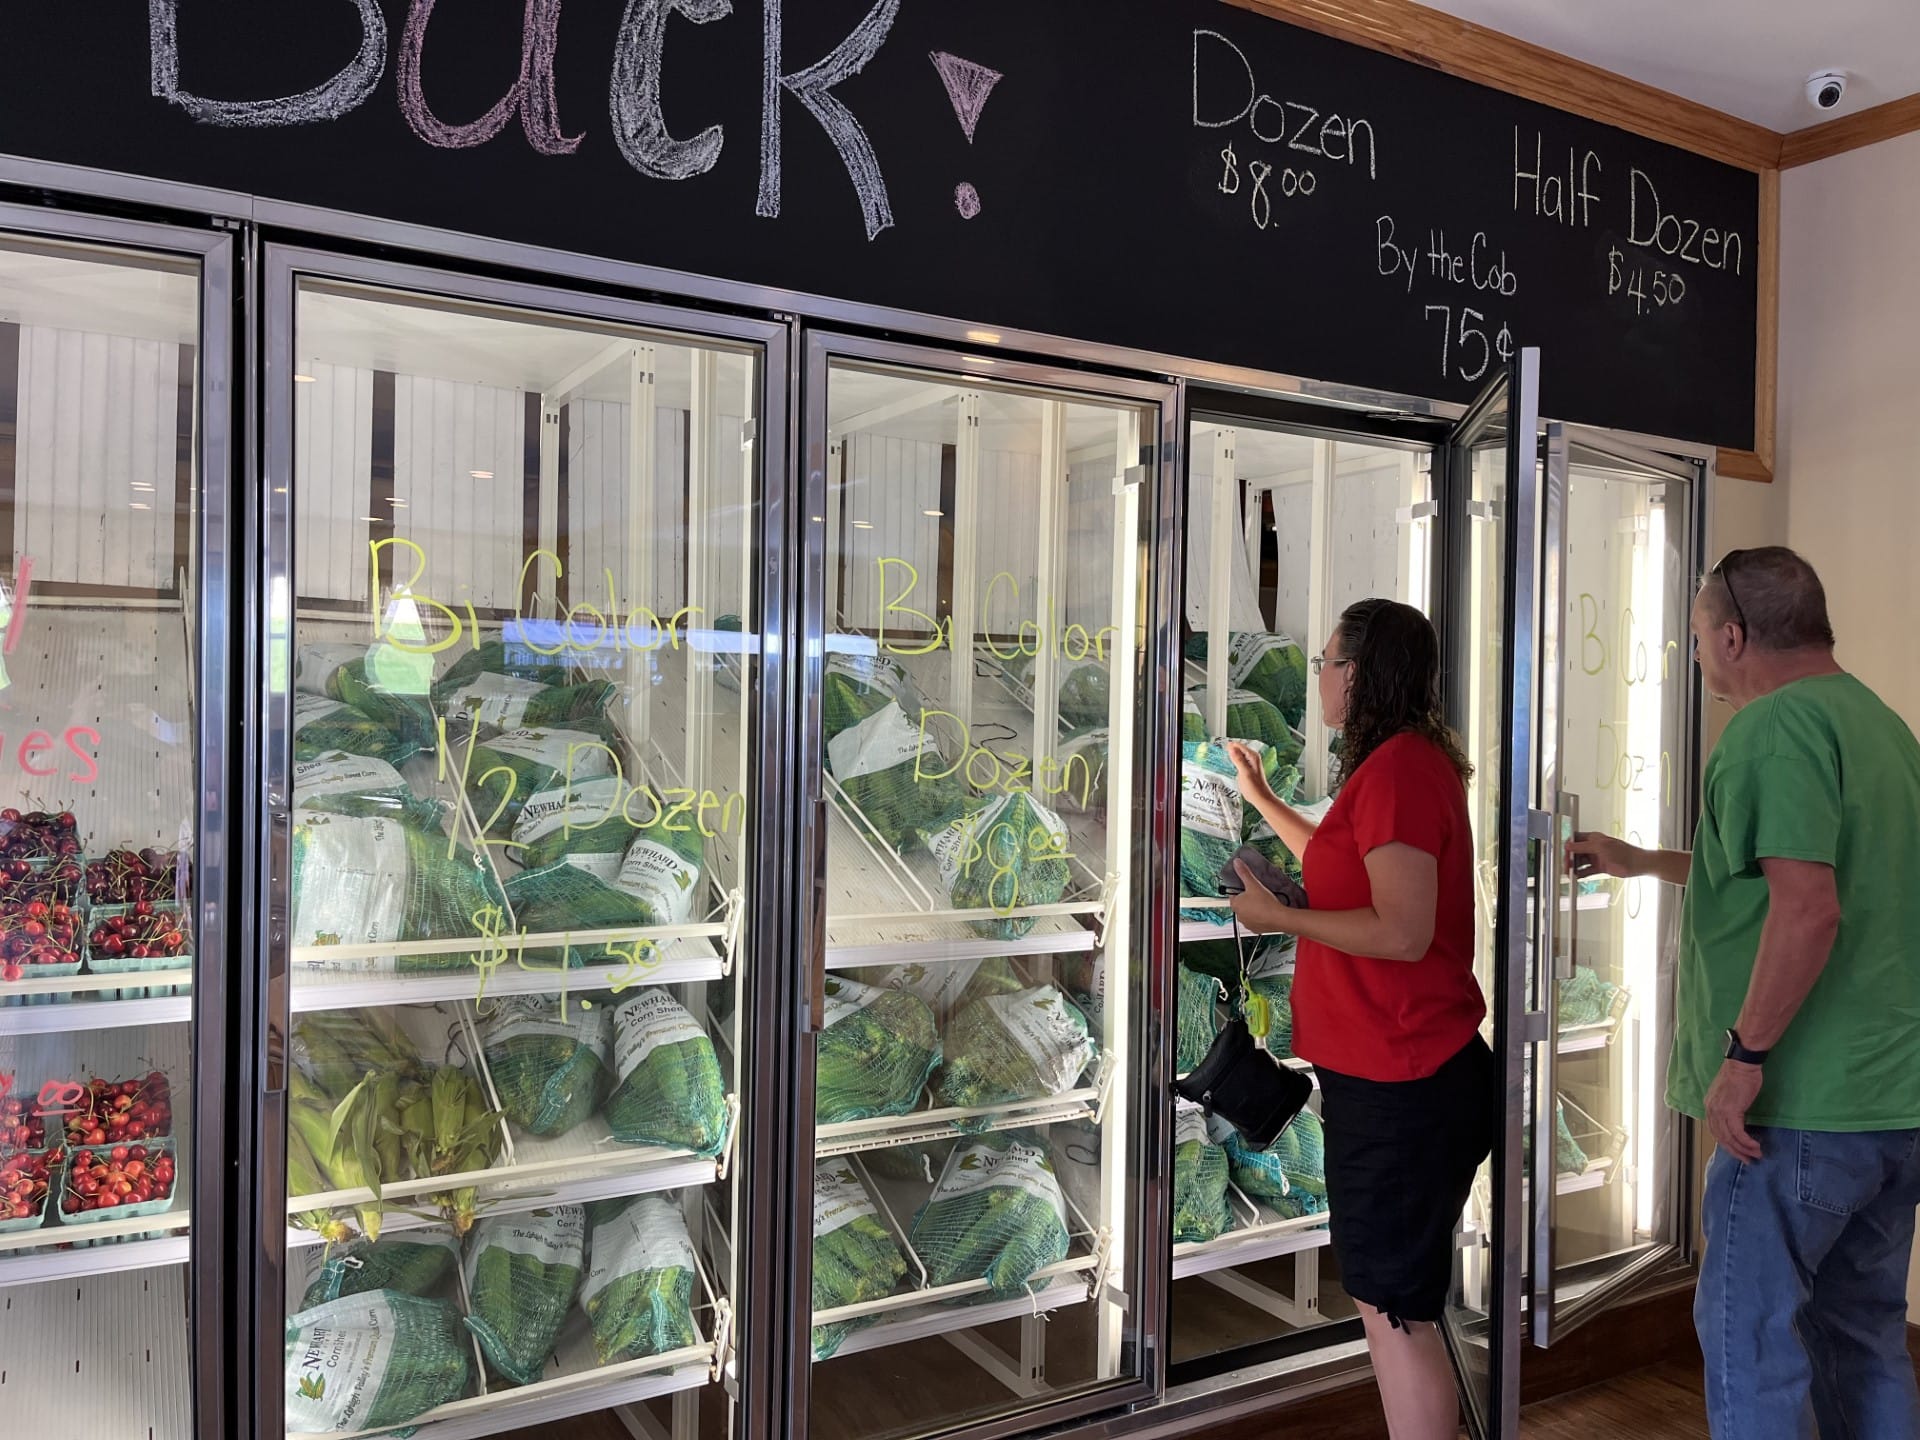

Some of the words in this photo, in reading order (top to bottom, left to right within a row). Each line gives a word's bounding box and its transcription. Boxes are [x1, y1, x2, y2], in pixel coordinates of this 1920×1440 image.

[1192, 28, 1377, 180] Dozen
[1513, 124, 1601, 227] Half
[1626, 167, 1743, 276] Dozen
[1376, 215, 1417, 293] By
[1427, 229, 1465, 283] the
[1470, 231, 1518, 296] Cob
[1607, 245, 1687, 315] $4.50
[369, 537, 481, 655] Bi
[515, 548, 705, 656] Color
[877, 556, 955, 656] Bi
[983, 571, 1121, 662] Color
[1619, 607, 1678, 687] Cor
[0, 725, 101, 784] es
[562, 741, 748, 842] Dozen
[913, 707, 1090, 812] Dozen
[1596, 720, 1672, 808] Dozn
[523, 799, 565, 820] NEWHA
[623, 994, 679, 1022] NEWHAR
[630, 1010, 655, 1027] Corn
